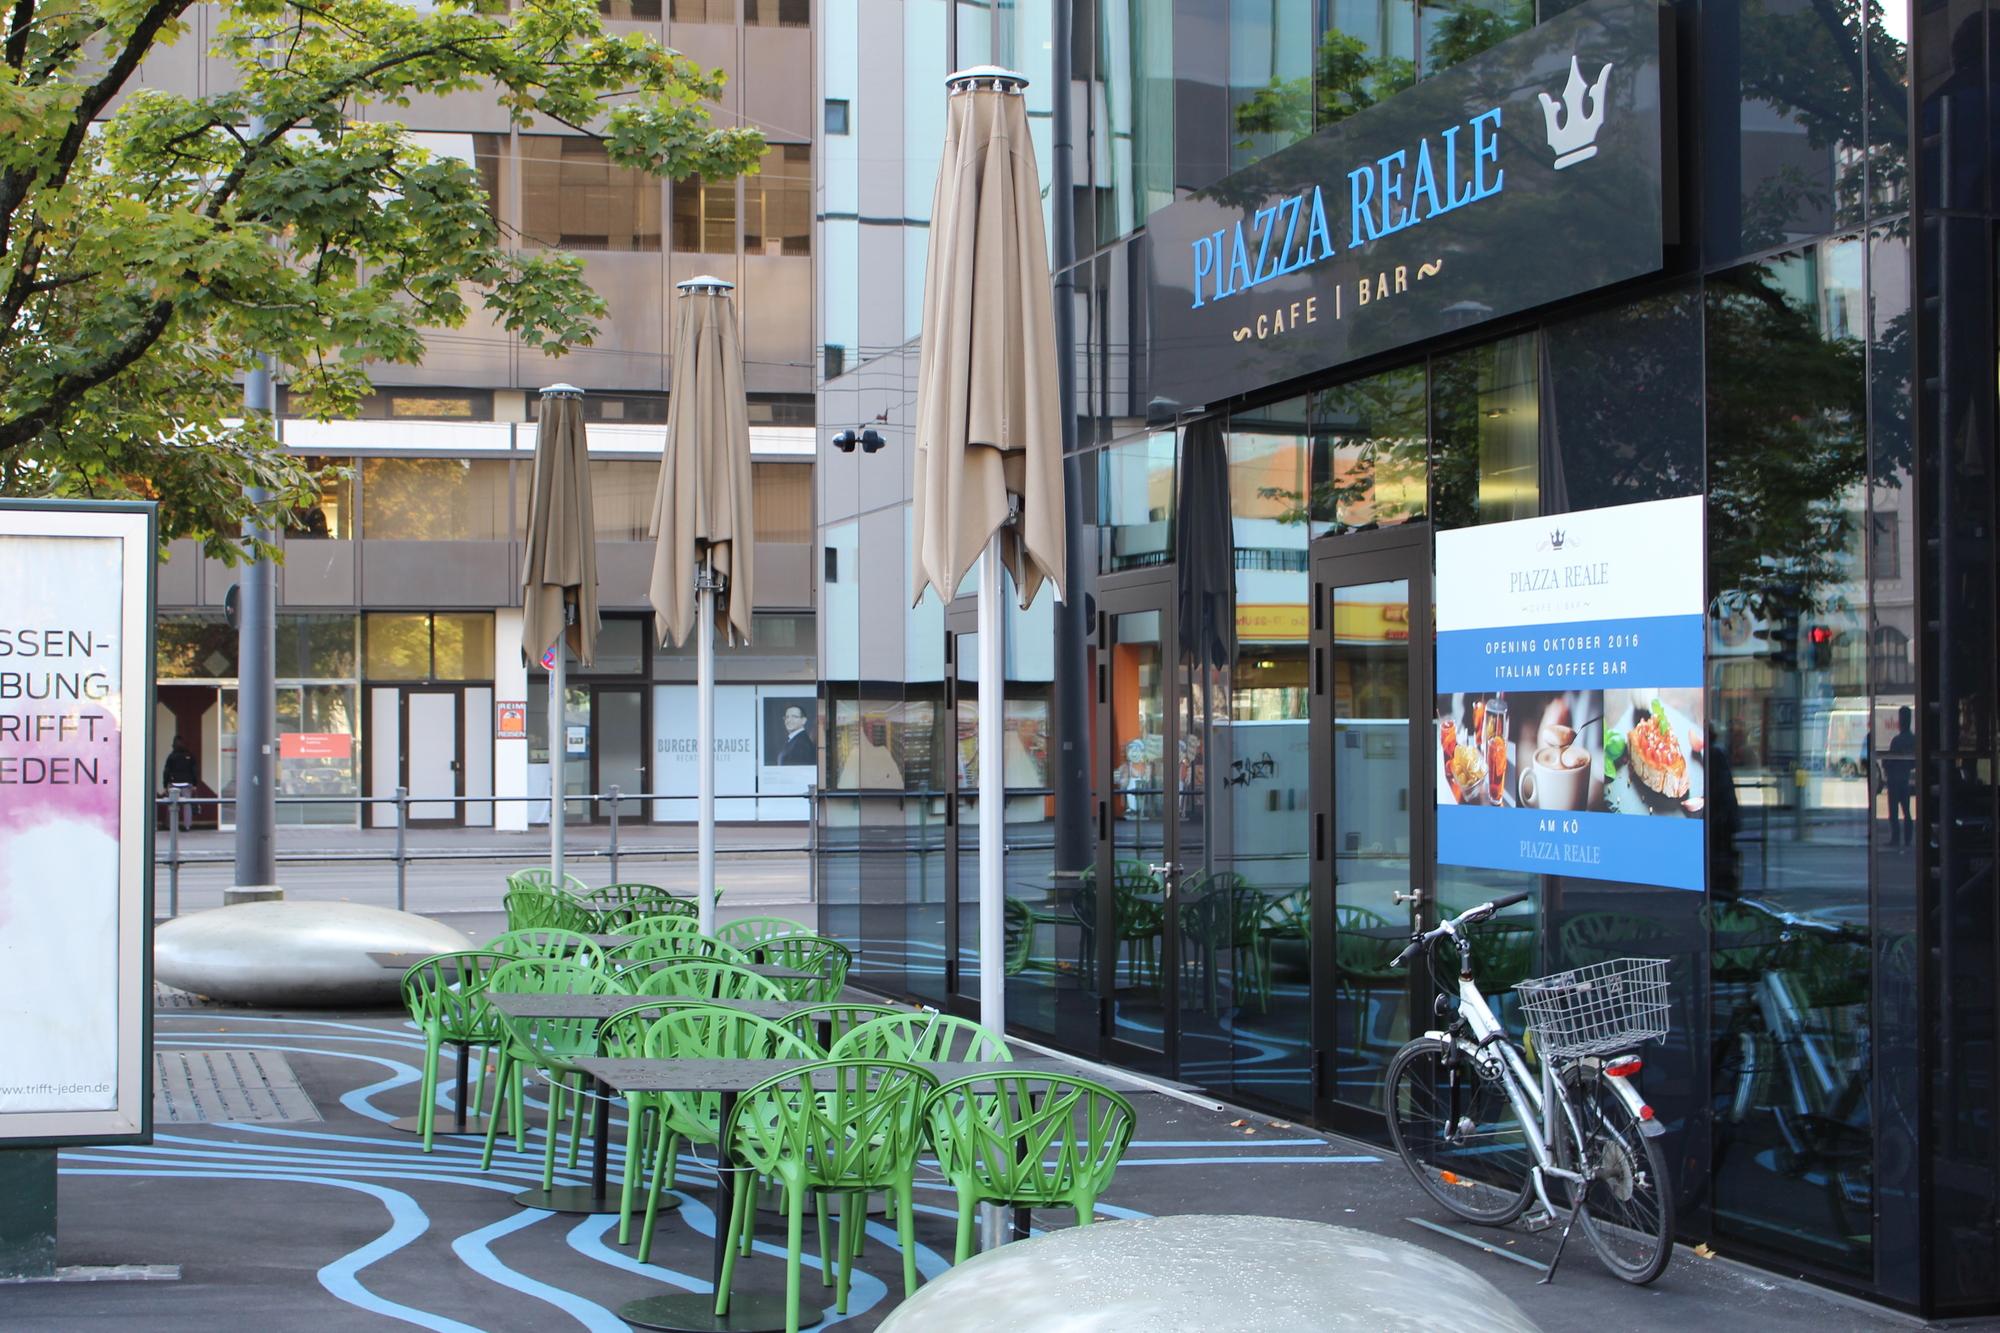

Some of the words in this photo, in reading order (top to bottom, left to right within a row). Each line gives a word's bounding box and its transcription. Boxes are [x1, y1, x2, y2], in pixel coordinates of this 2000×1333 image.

[1191, 184, 1335, 310] PIAZZA
[1347, 108, 1504, 249] REALE
[1256, 296, 1317, 340] CAFE
[1359, 265, 1408, 306] BAR
[1510, 568, 1560, 593] PIAZZA
[1564, 562, 1609, 588] REALE
[1529, 603, 1551, 613] CAFE
[1564, 601, 1580, 610] BAR
[0, 629, 109, 657] SSEN-
[1485, 640, 1536, 654] OPENING
[1543, 636, 1601, 651] OKTOBER
[1608, 634, 1639, 648] 2016
[1495, 665, 1540, 678] ITALIAN
[1547, 662, 1595, 676] COFFEE
[1602, 661, 1627, 675] BAR
[0, 672, 109, 699] BUNG
[0, 715, 108, 742] RIFFT.
[657, 739, 698, 752] BURGER
[0, 758, 108, 784] EDEN.
[1539, 819, 1555, 832] AM
[1520, 840, 1560, 860] PIAZZA
[1563, 844, 1600, 864] REALE
